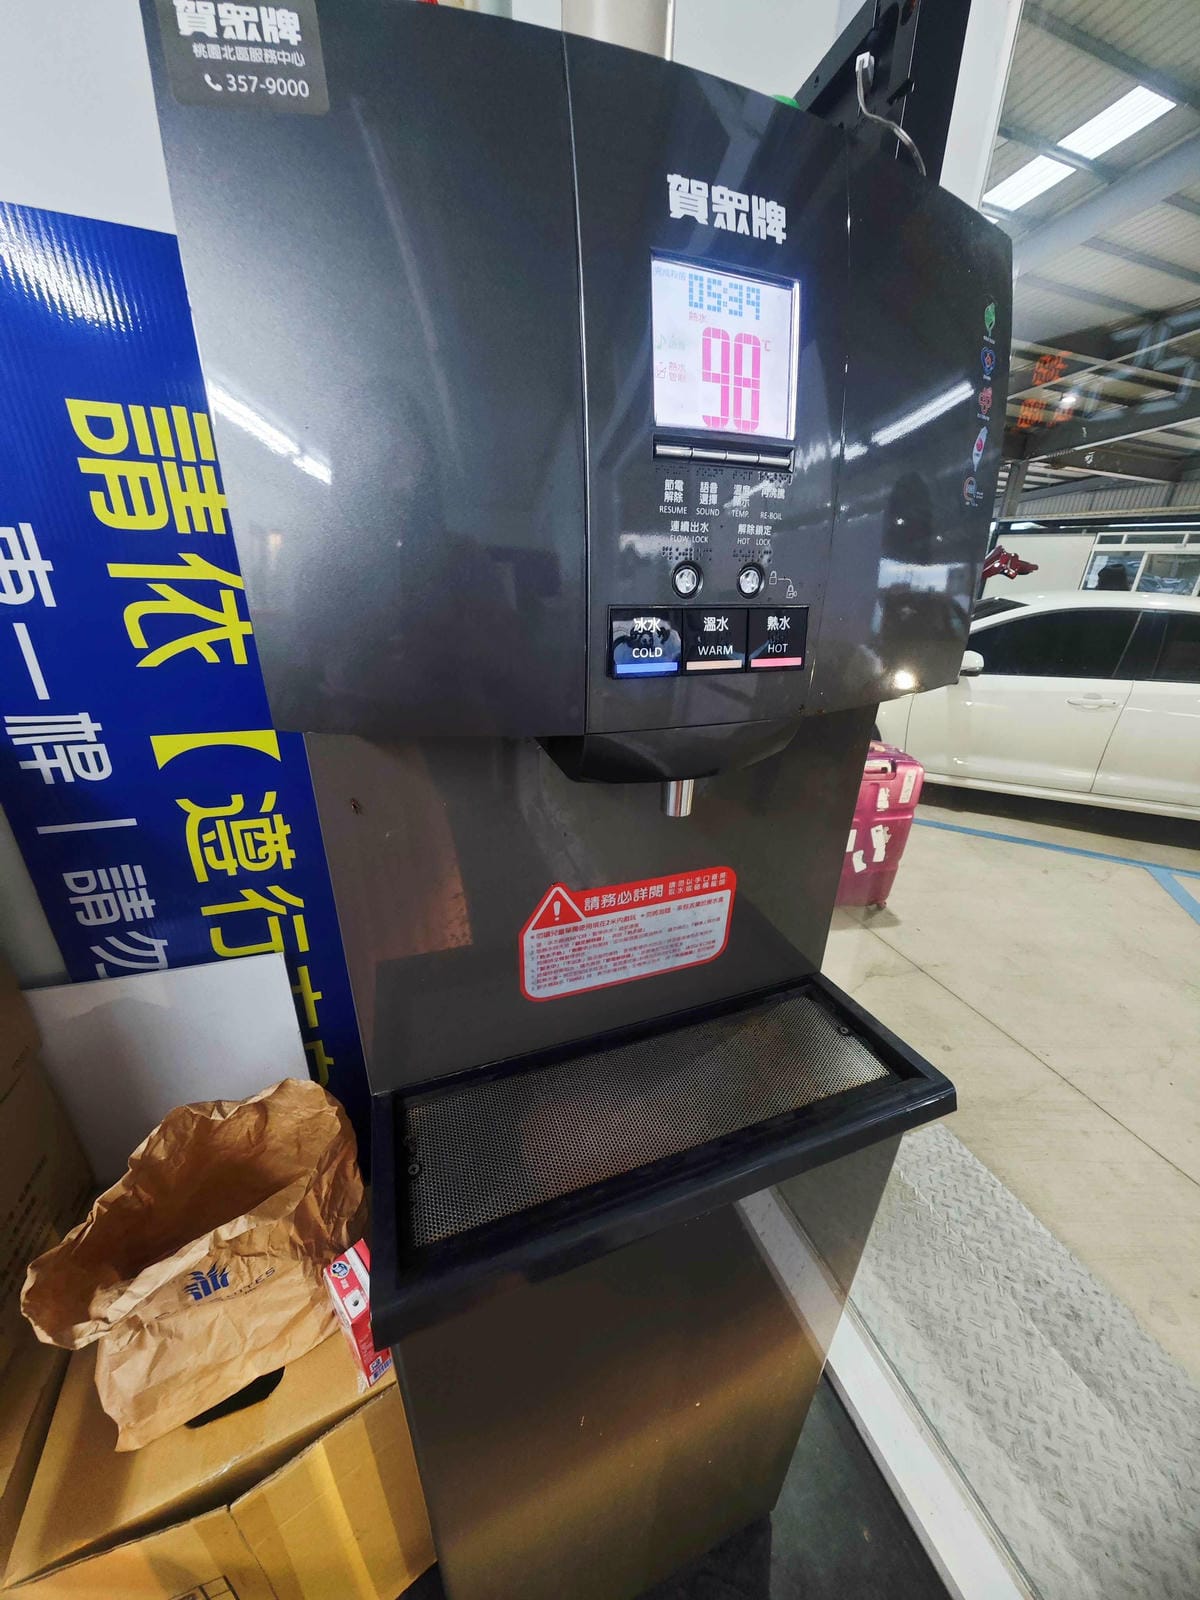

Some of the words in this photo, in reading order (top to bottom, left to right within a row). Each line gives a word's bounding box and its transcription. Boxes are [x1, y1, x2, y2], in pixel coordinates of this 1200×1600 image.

[192, 42, 306, 67] 桃園北區服務中心
[226, 74, 310, 98] 357-9000
[688, 273, 761, 321] 05:39
[702, 326, 761, 432] 98
[659, 505, 688, 515] RESUME
[695, 507, 720, 517] SOUND
[760, 511, 783, 521] RE-BOIL
[670, 520, 710, 533] 連續出水
[737, 523, 773, 536] 解除鎖定
[670, 534, 690, 543] FLOW
[691, 535, 709, 543] LOCK
[737, 537, 751, 545] HOT
[755, 538, 772, 547] LOCK
[633, 616, 662, 633] 冰水
[703, 616, 729, 632] 溫水
[767, 615, 791, 631] 熱水
[632, 647, 663, 659] COLD
[698, 645, 734, 656] WARM
[767, 643, 789, 654] HOT
[584, 884, 664, 911] 請務必詳閱
